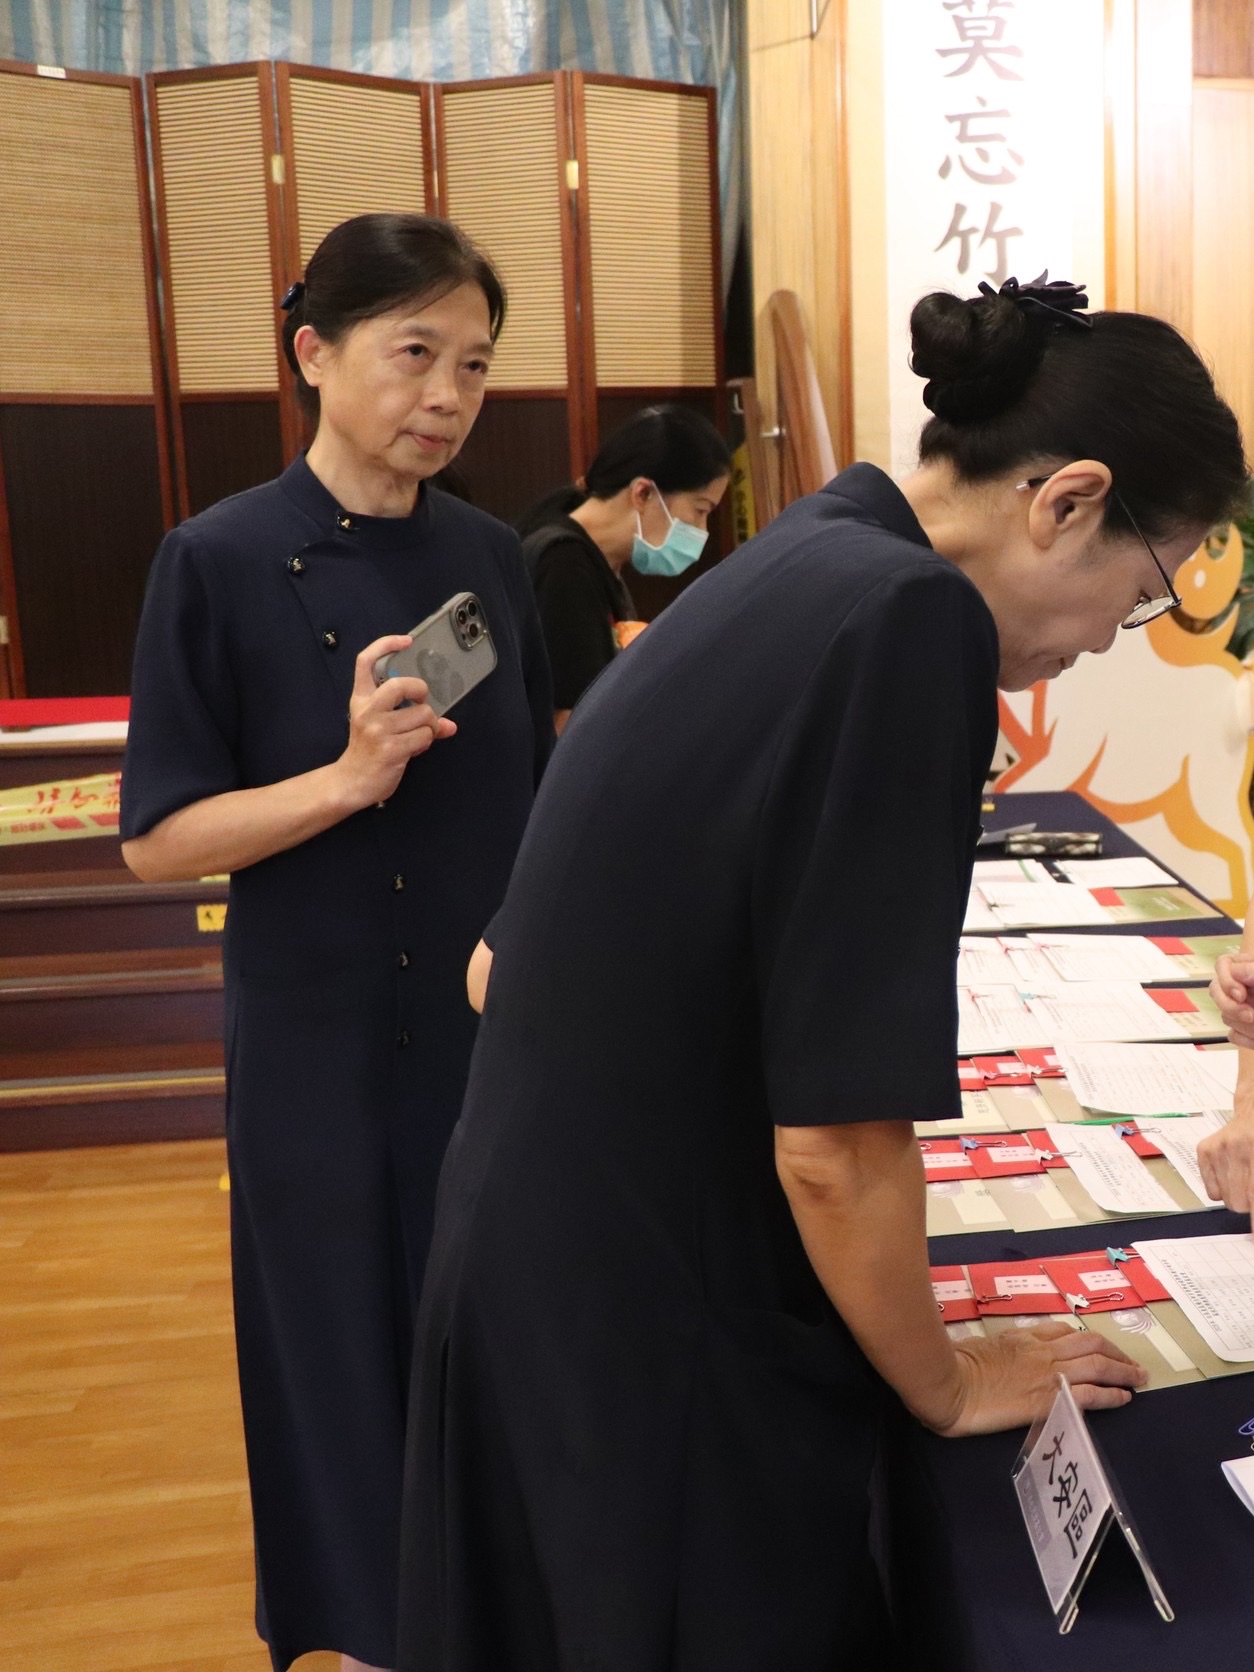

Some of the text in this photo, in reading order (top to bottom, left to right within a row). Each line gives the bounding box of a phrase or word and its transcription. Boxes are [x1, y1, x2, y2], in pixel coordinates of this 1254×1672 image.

[934, 0, 1025, 287] 莫忘竹
[1042, 1431, 1093, 1559] 大安區
